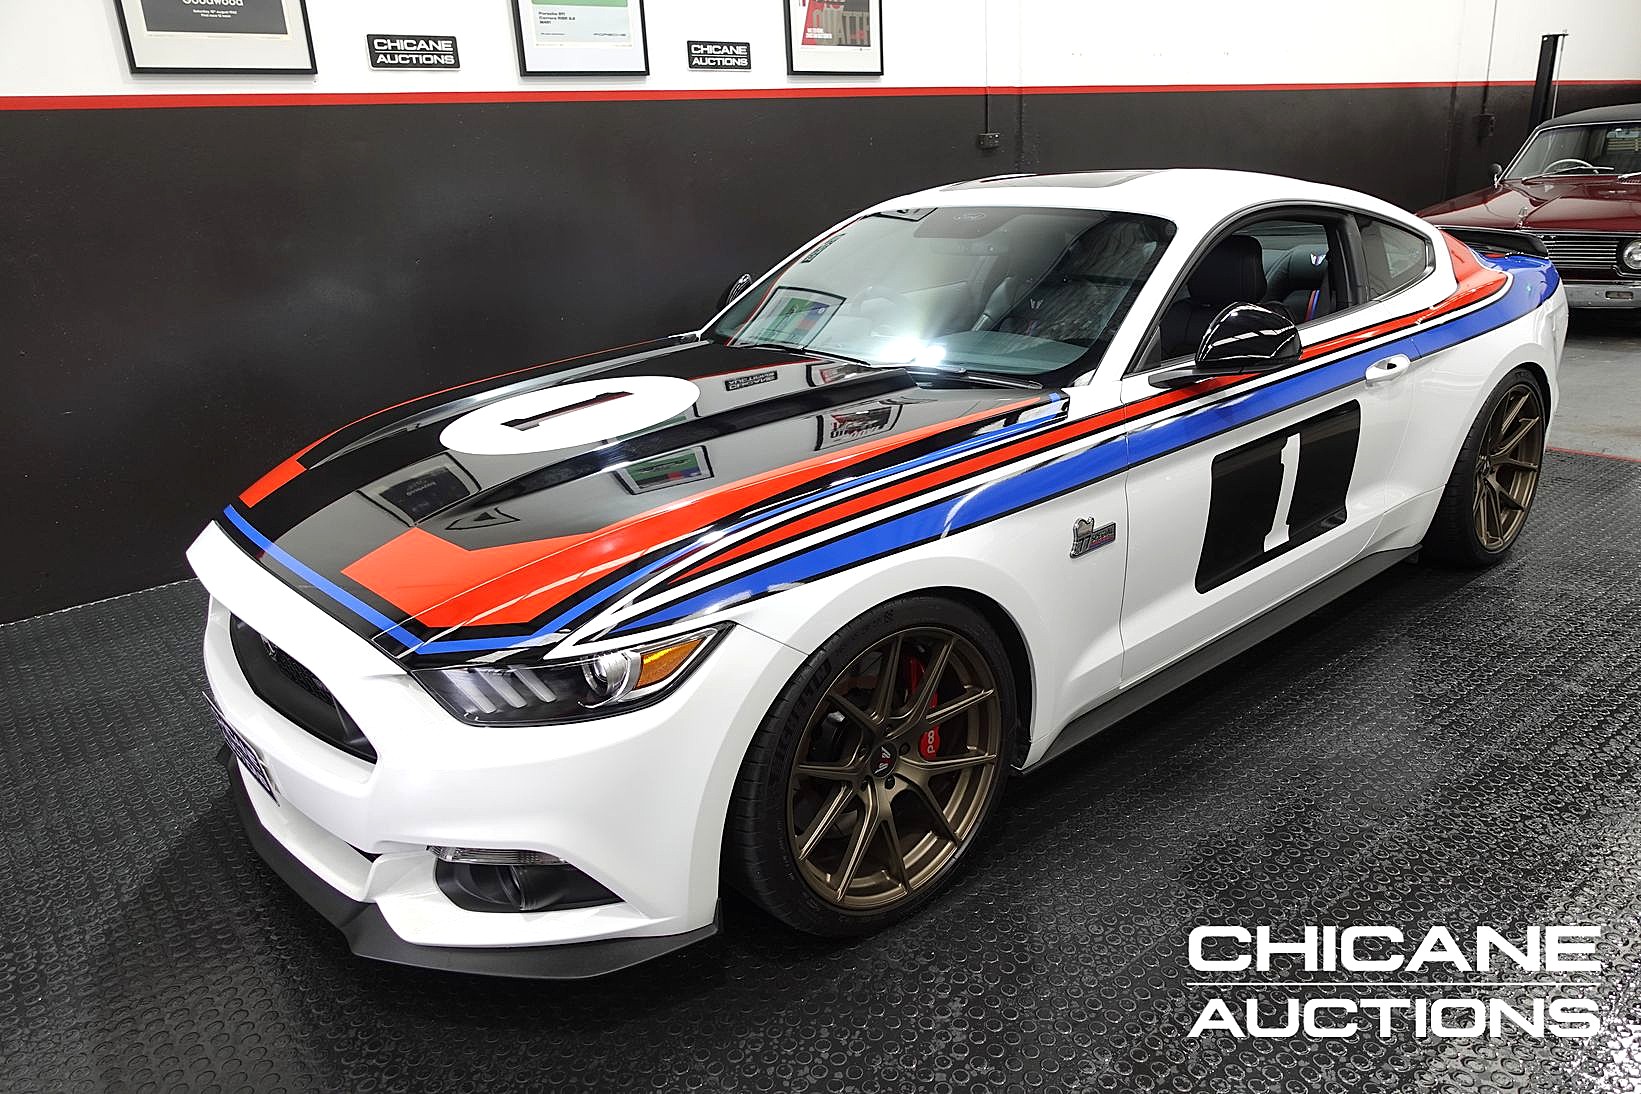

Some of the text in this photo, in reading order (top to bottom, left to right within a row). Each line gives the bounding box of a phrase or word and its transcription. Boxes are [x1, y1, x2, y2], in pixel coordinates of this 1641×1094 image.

[373, 39, 454, 51] CHICANE
[691, 44, 748, 55] CHICANE
[376, 53, 456, 65] AUCTIONS
[692, 57, 749, 67] AUCTIONS
[500, 391, 634, 431] 1
[1263, 432, 1300, 553] 1
